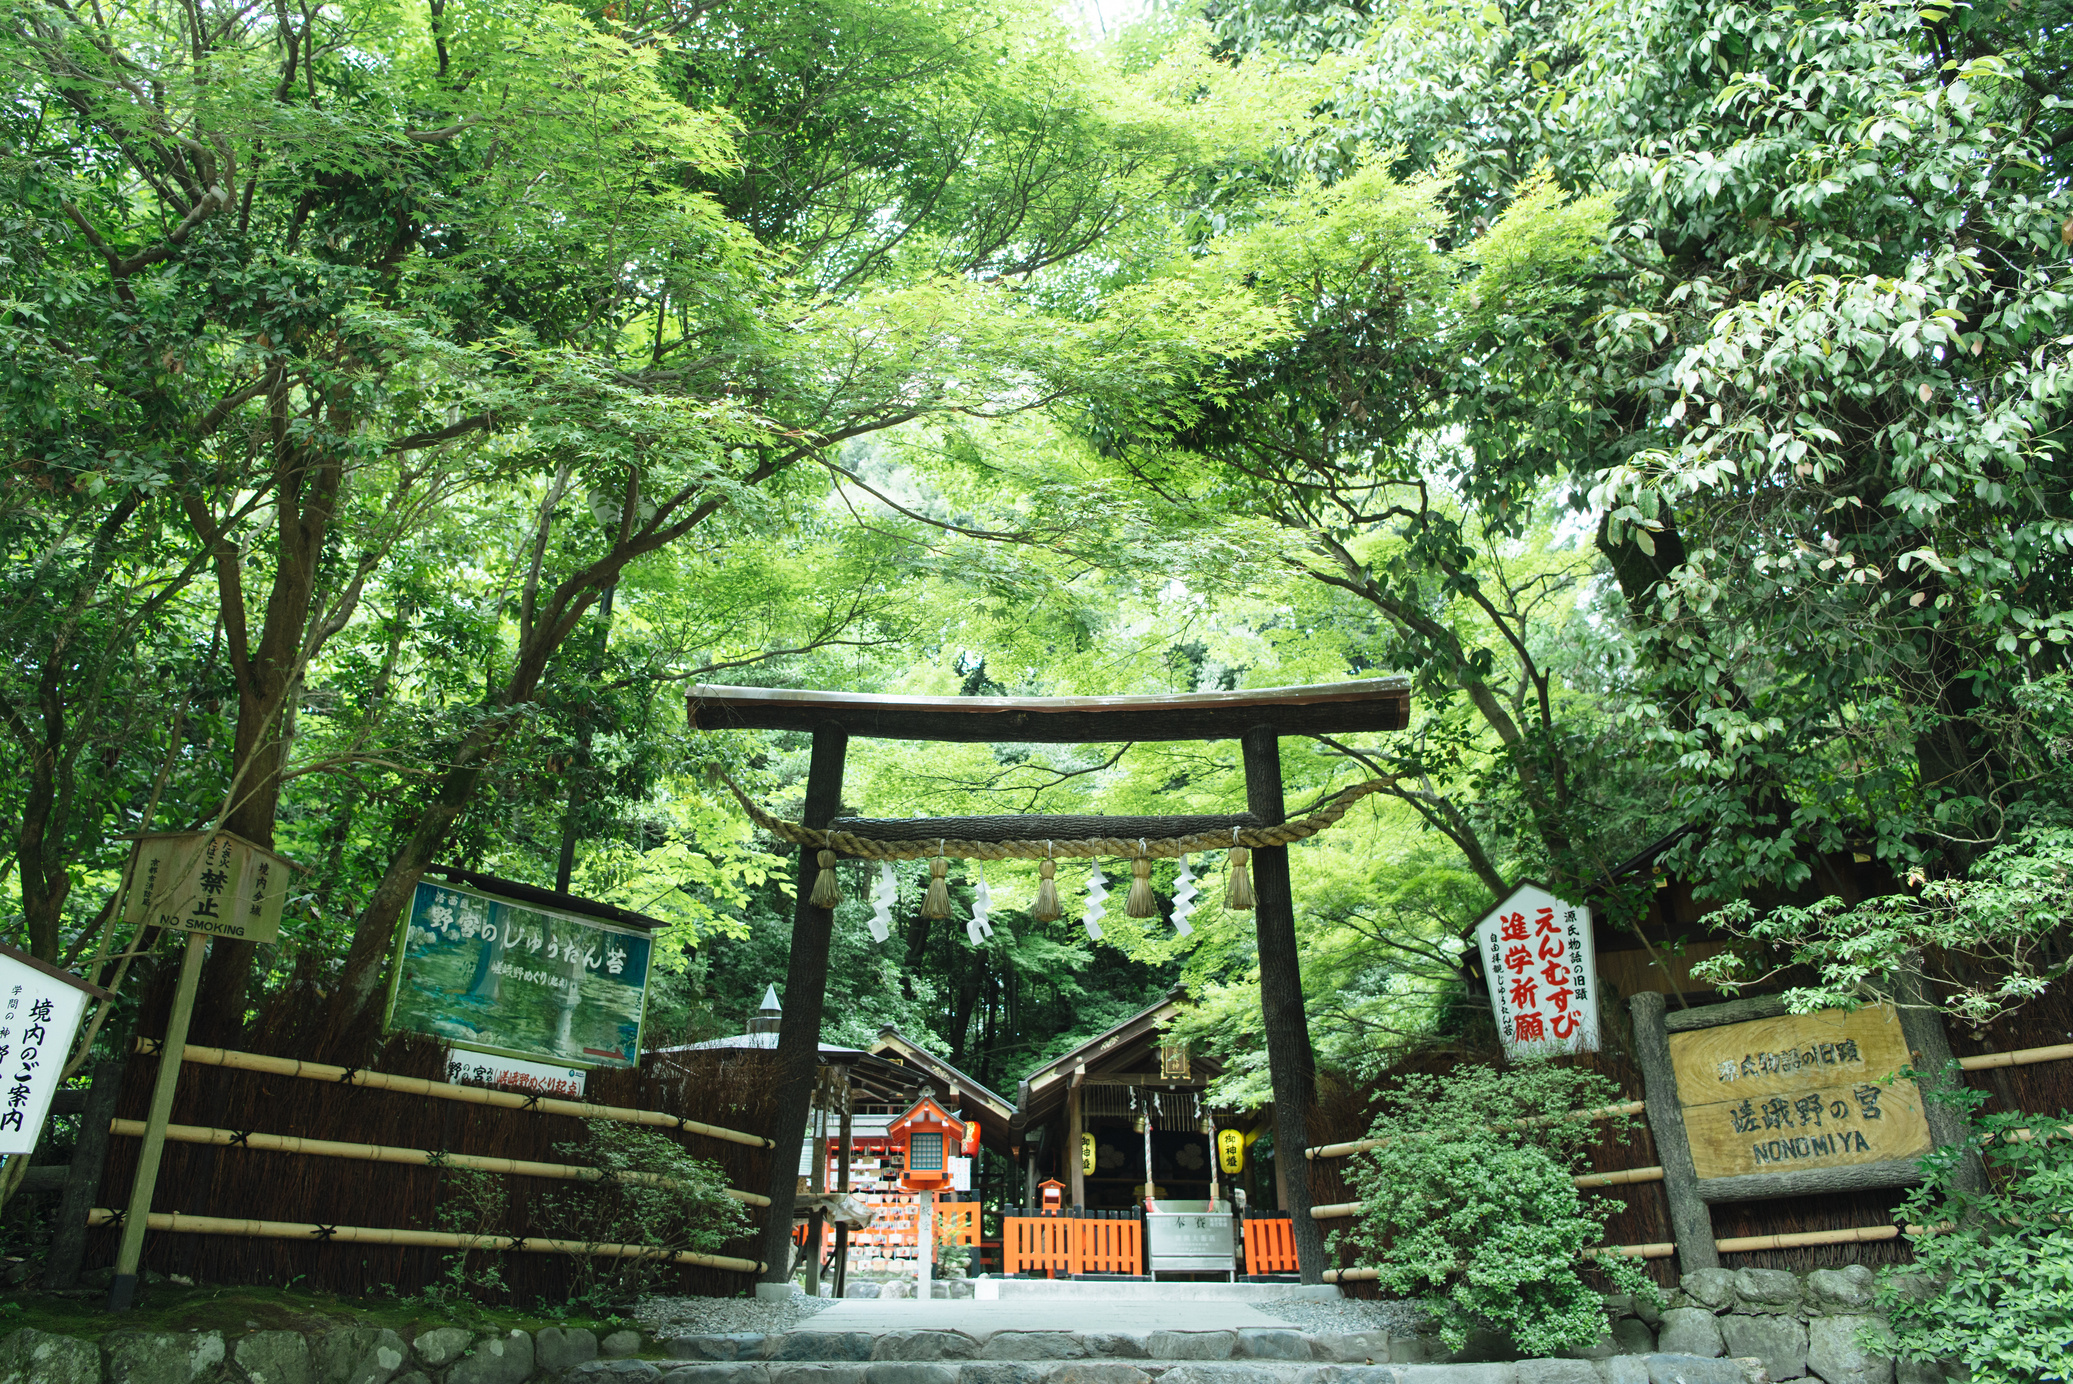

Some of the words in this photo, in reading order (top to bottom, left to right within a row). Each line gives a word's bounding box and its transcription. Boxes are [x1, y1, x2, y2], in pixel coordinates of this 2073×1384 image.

[219, 840, 232, 868] たき火
[192, 868, 228, 919] 禁止
[160, 914, 180, 926] NO
[185, 918, 245, 936] SMOKING
[1500, 911, 1545, 1043] 進学祈願
[1535, 907, 1582, 1040] えんむすび
[1564, 910, 1588, 1000] 源氏物語の旧蹟
[0, 998, 54, 1132] 境内のご案内
[1717, 1038, 1862, 1082] 源氏物語の旧蹟
[1730, 1083, 1882, 1134] 嵯峨野の宮
[1752, 1129, 1872, 1165] NONOMIYA
